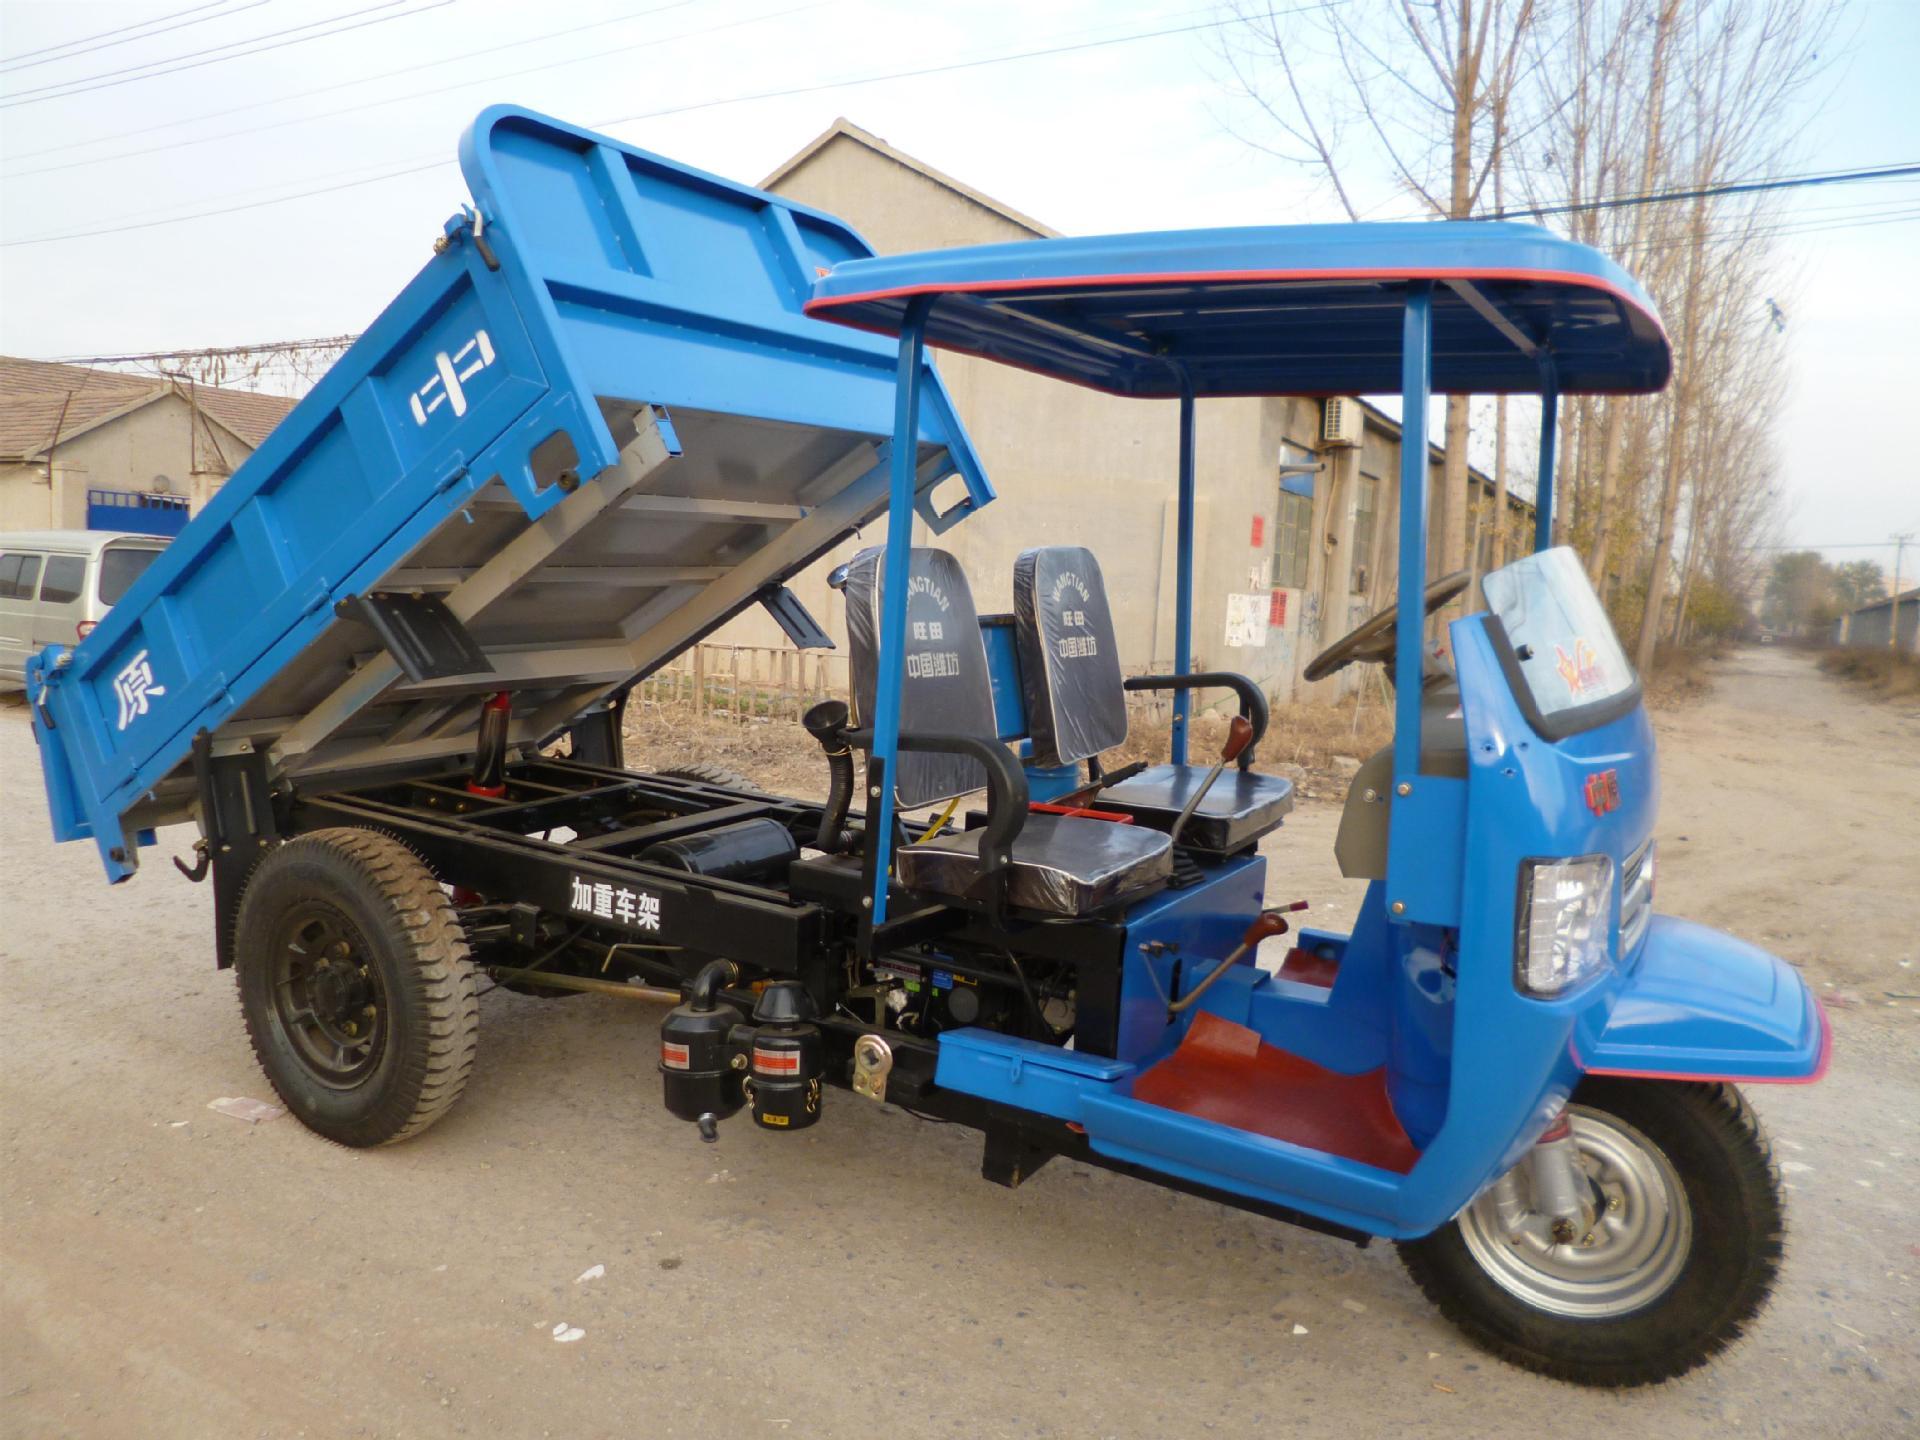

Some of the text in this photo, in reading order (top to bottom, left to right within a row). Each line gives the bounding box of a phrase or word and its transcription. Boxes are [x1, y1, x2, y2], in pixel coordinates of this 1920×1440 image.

[410, 329, 496, 427] 中
[906, 576, 950, 612] ANGTIAN
[1052, 571, 1090, 602] WANGTIAN
[913, 621, 943, 640] 旺田
[1059, 636, 1097, 658] 中国潍坊
[906, 652, 960, 679] 中国潍坊
[113, 649, 166, 731] 原
[571, 876, 660, 931] 加重车架
